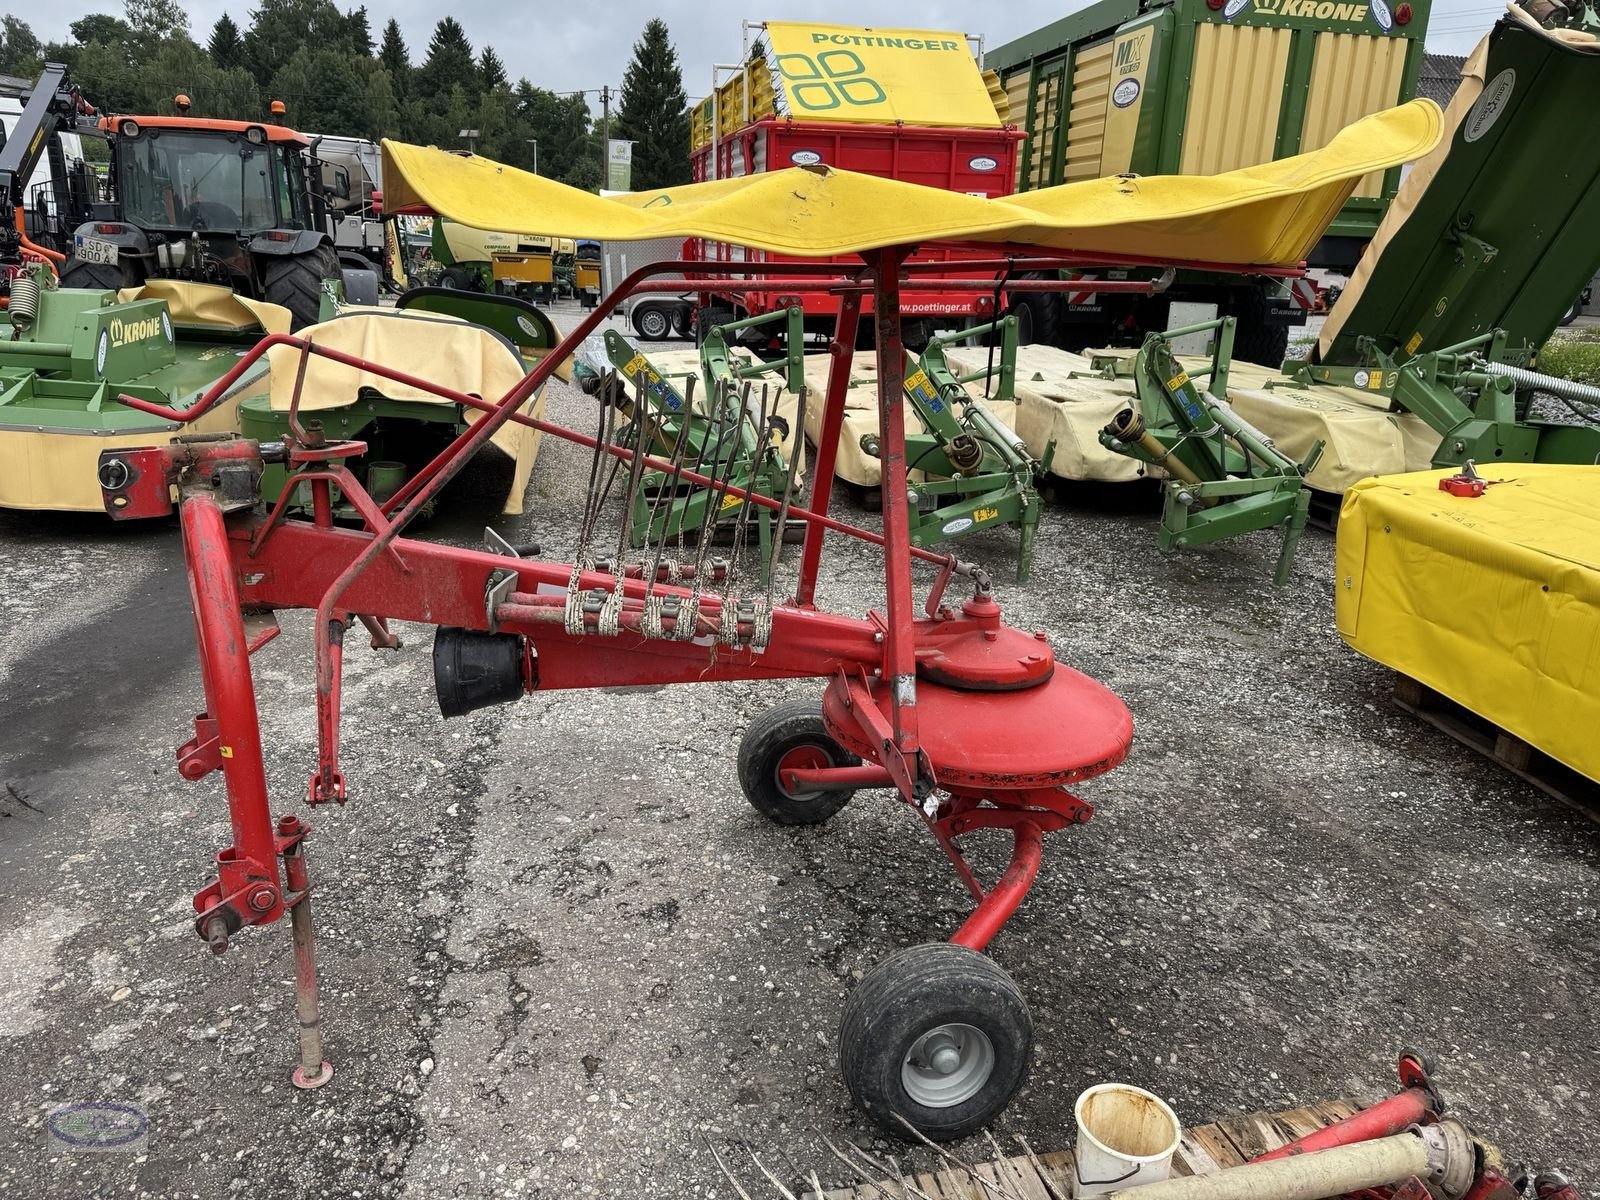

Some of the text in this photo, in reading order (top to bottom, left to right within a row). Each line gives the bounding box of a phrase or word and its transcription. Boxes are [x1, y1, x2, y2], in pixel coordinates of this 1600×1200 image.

[1280, 0, 1368, 21] KRONE
[812, 33, 959, 51] PÖTTINGER
[1115, 34, 1145, 67] MX
[1495, 82, 1509, 101] Land
[89, 241, 102, 251] SD
[124, 316, 160, 344] KRONE
